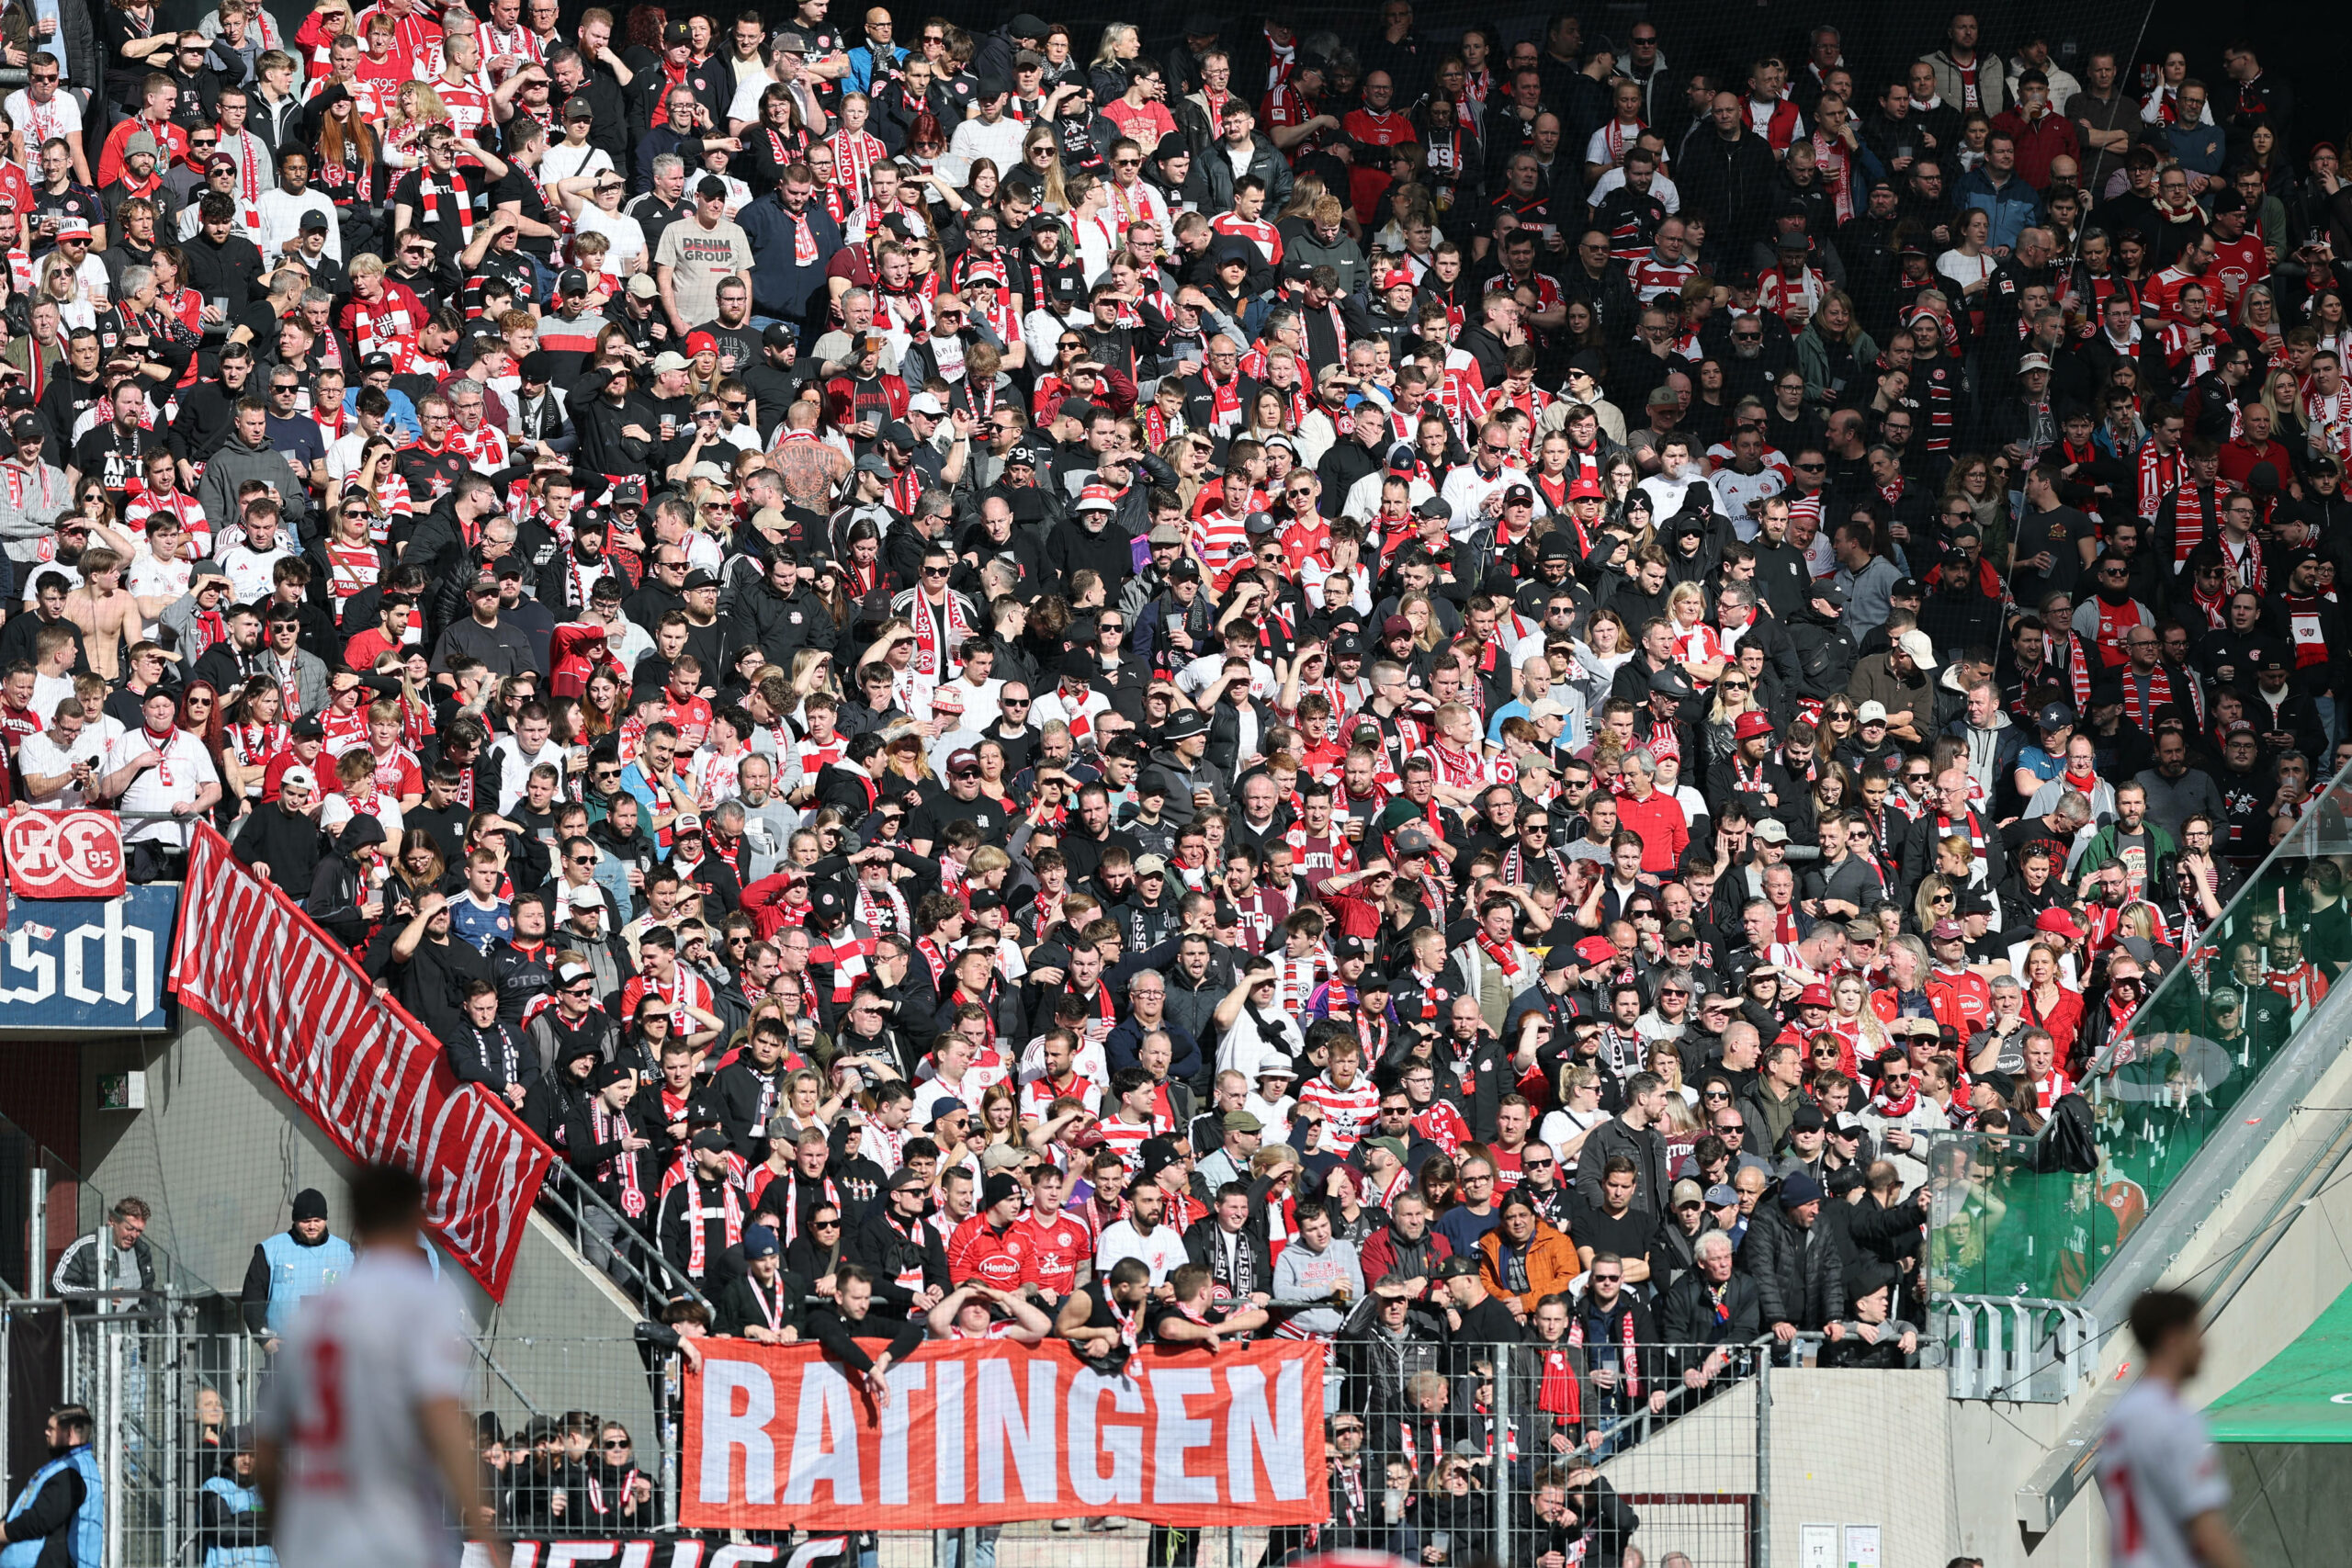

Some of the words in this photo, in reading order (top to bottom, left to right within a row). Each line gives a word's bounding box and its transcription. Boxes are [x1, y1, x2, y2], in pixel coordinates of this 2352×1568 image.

[679, 25, 687, 33] P
[61, 219, 79, 230] KÖLN
[683, 238, 730, 251] DENIM
[684, 251, 733, 262] GROUP
[1361, 726, 1376, 734] ICON
[988, 1262, 1016, 1273] Henkel
[699, 1357, 1306, 1505] RATINGEN
